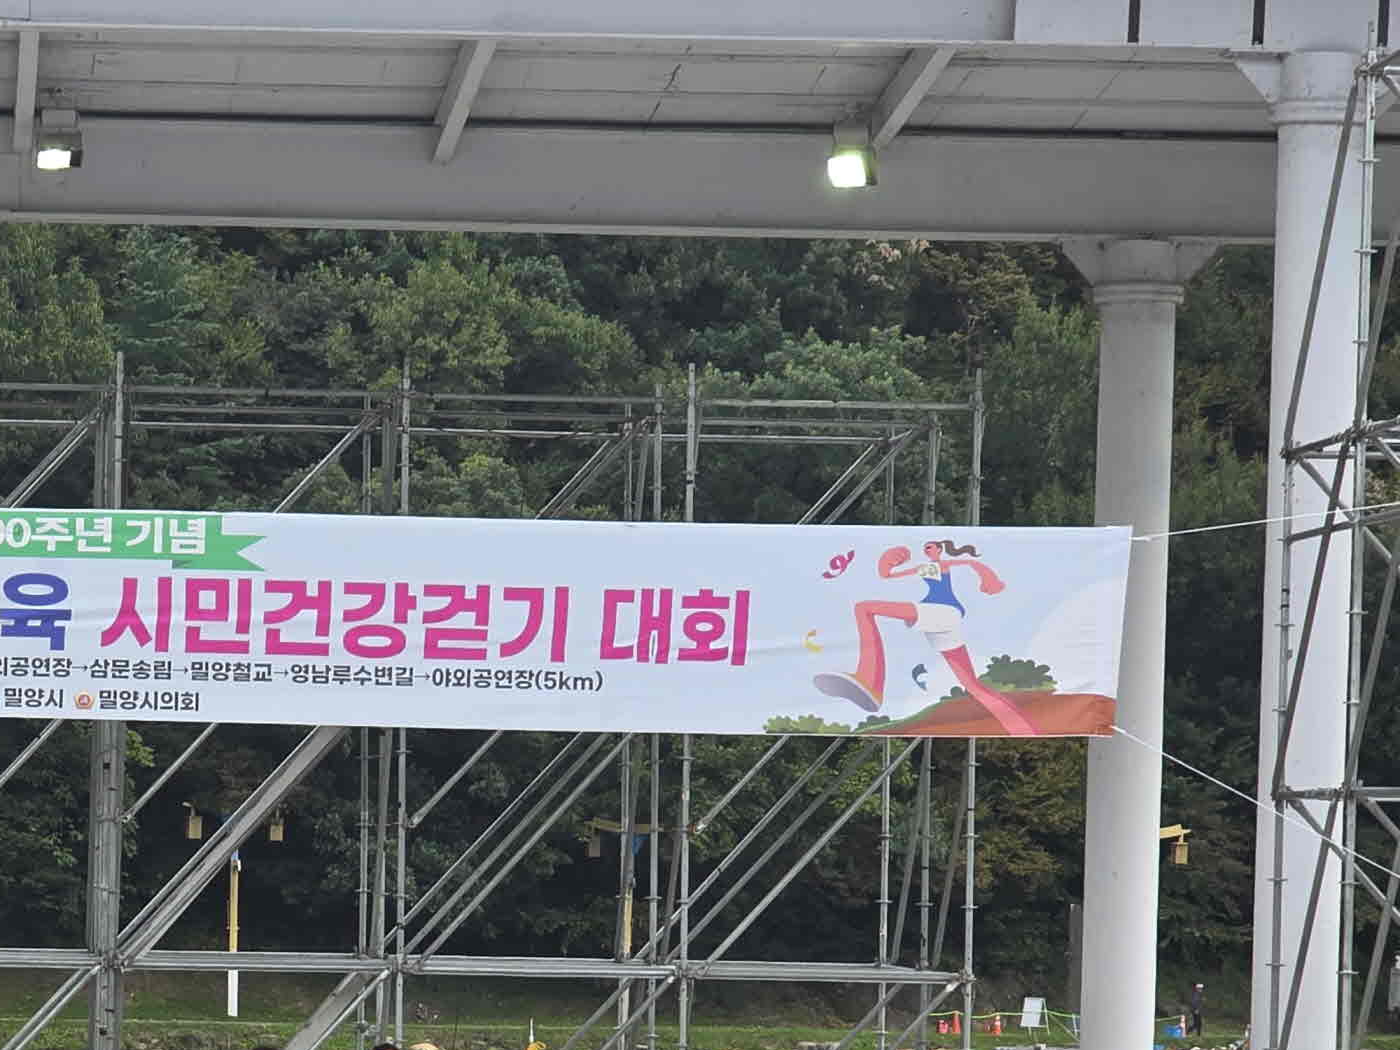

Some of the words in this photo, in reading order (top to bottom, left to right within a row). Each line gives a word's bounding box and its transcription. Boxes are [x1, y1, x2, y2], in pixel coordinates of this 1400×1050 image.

[124, 517, 207, 555] 기념
[100, 576, 570, 663] 시민건강걷기
[599, 587, 751, 666] 대회
[3, 687, 65, 710] 밀양시
[98, 689, 200, 712] 밀양시의회
